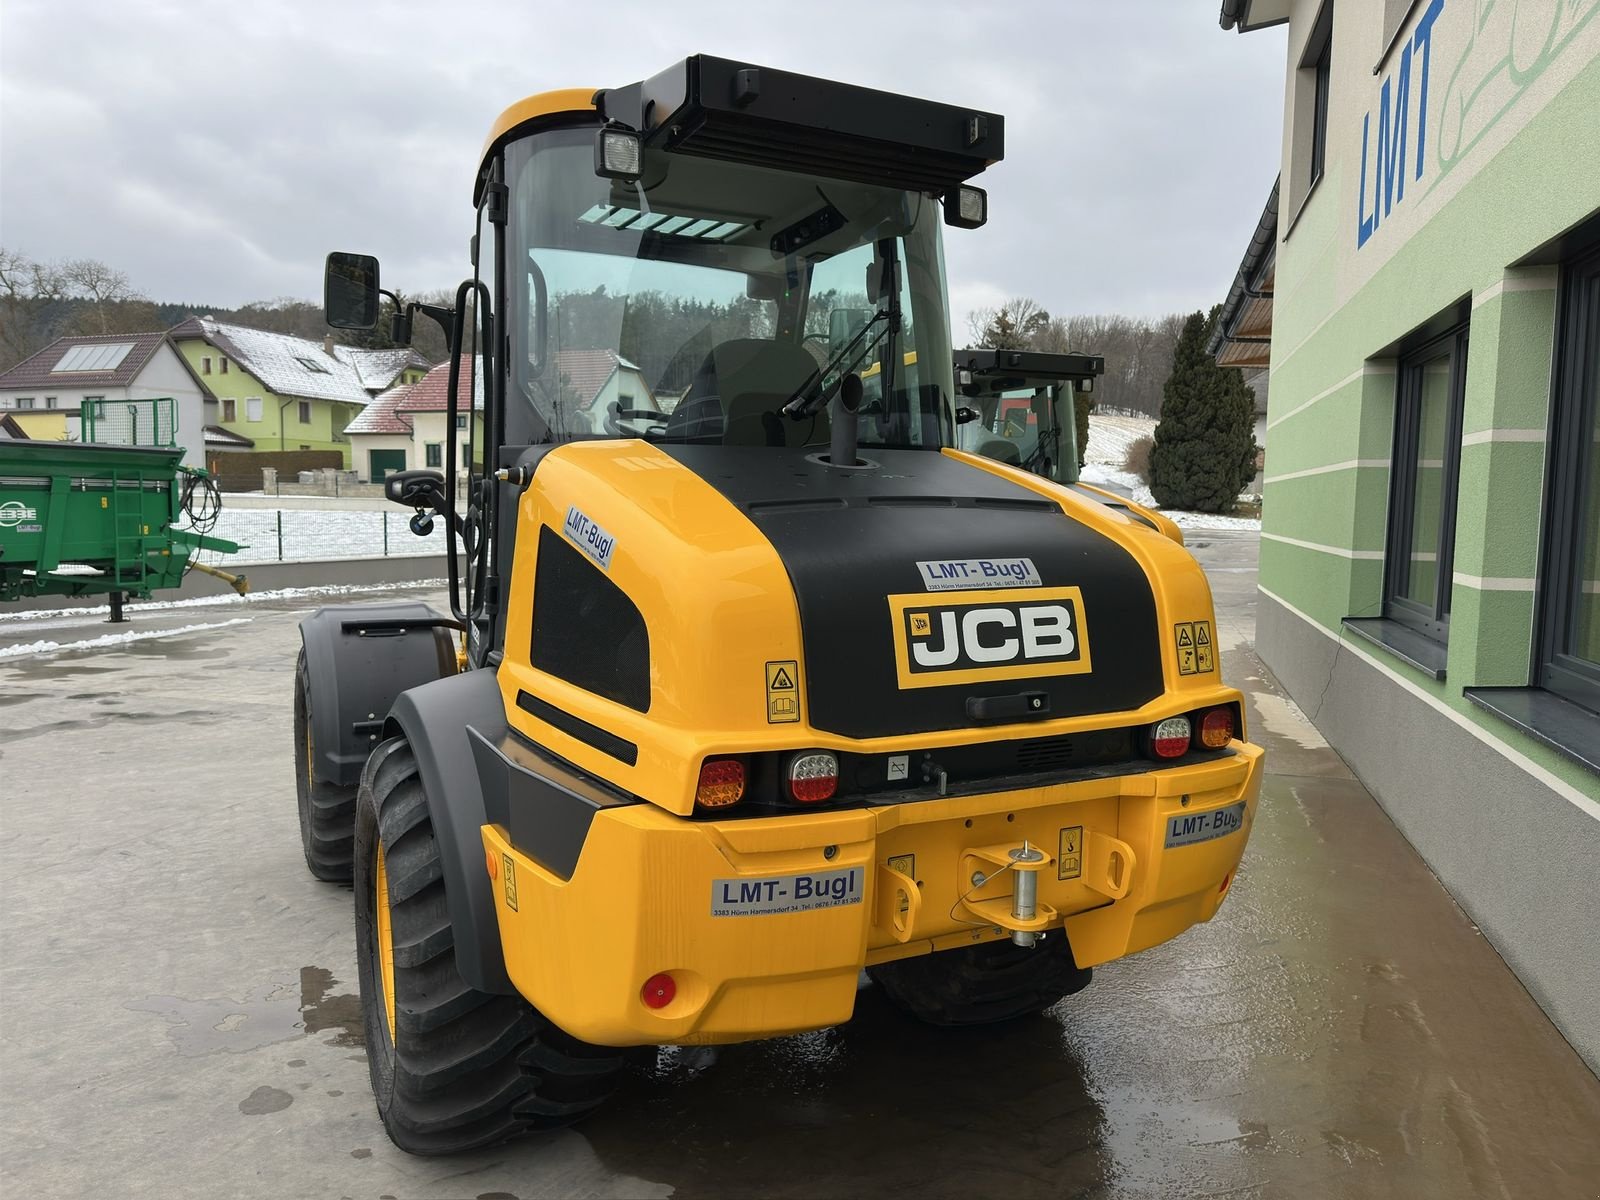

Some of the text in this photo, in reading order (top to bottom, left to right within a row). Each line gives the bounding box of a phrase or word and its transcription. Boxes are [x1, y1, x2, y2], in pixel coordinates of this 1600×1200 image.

[1358, 0, 1444, 251] LMT
[978, 560, 1031, 580] Bugl
[913, 605, 1074, 667] JCB
[723, 871, 855, 904] LMT- Bugl
[750, 905, 790, 915] Harmersdorf
